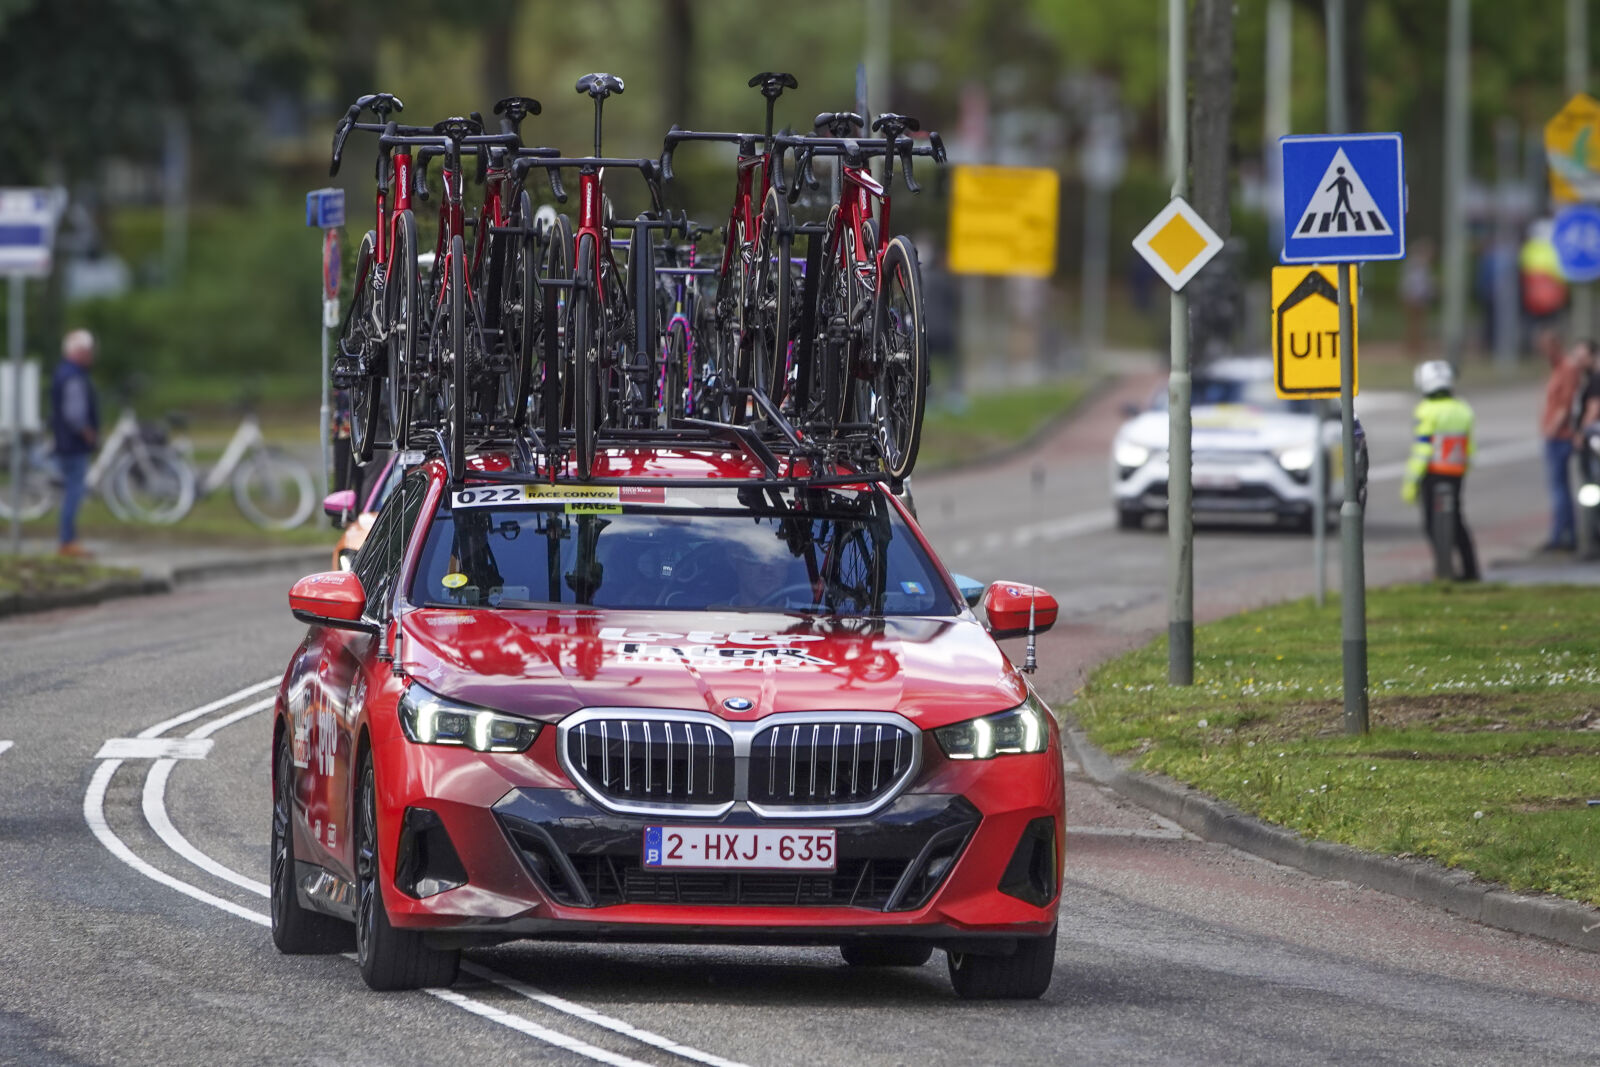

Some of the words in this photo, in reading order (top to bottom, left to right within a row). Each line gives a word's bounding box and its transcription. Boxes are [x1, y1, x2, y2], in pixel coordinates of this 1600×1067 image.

[1290, 331, 1341, 359] UIT
[457, 488, 521, 504] 022
[648, 848, 659, 862] B
[667, 833, 833, 862] 2-HXJ-635
